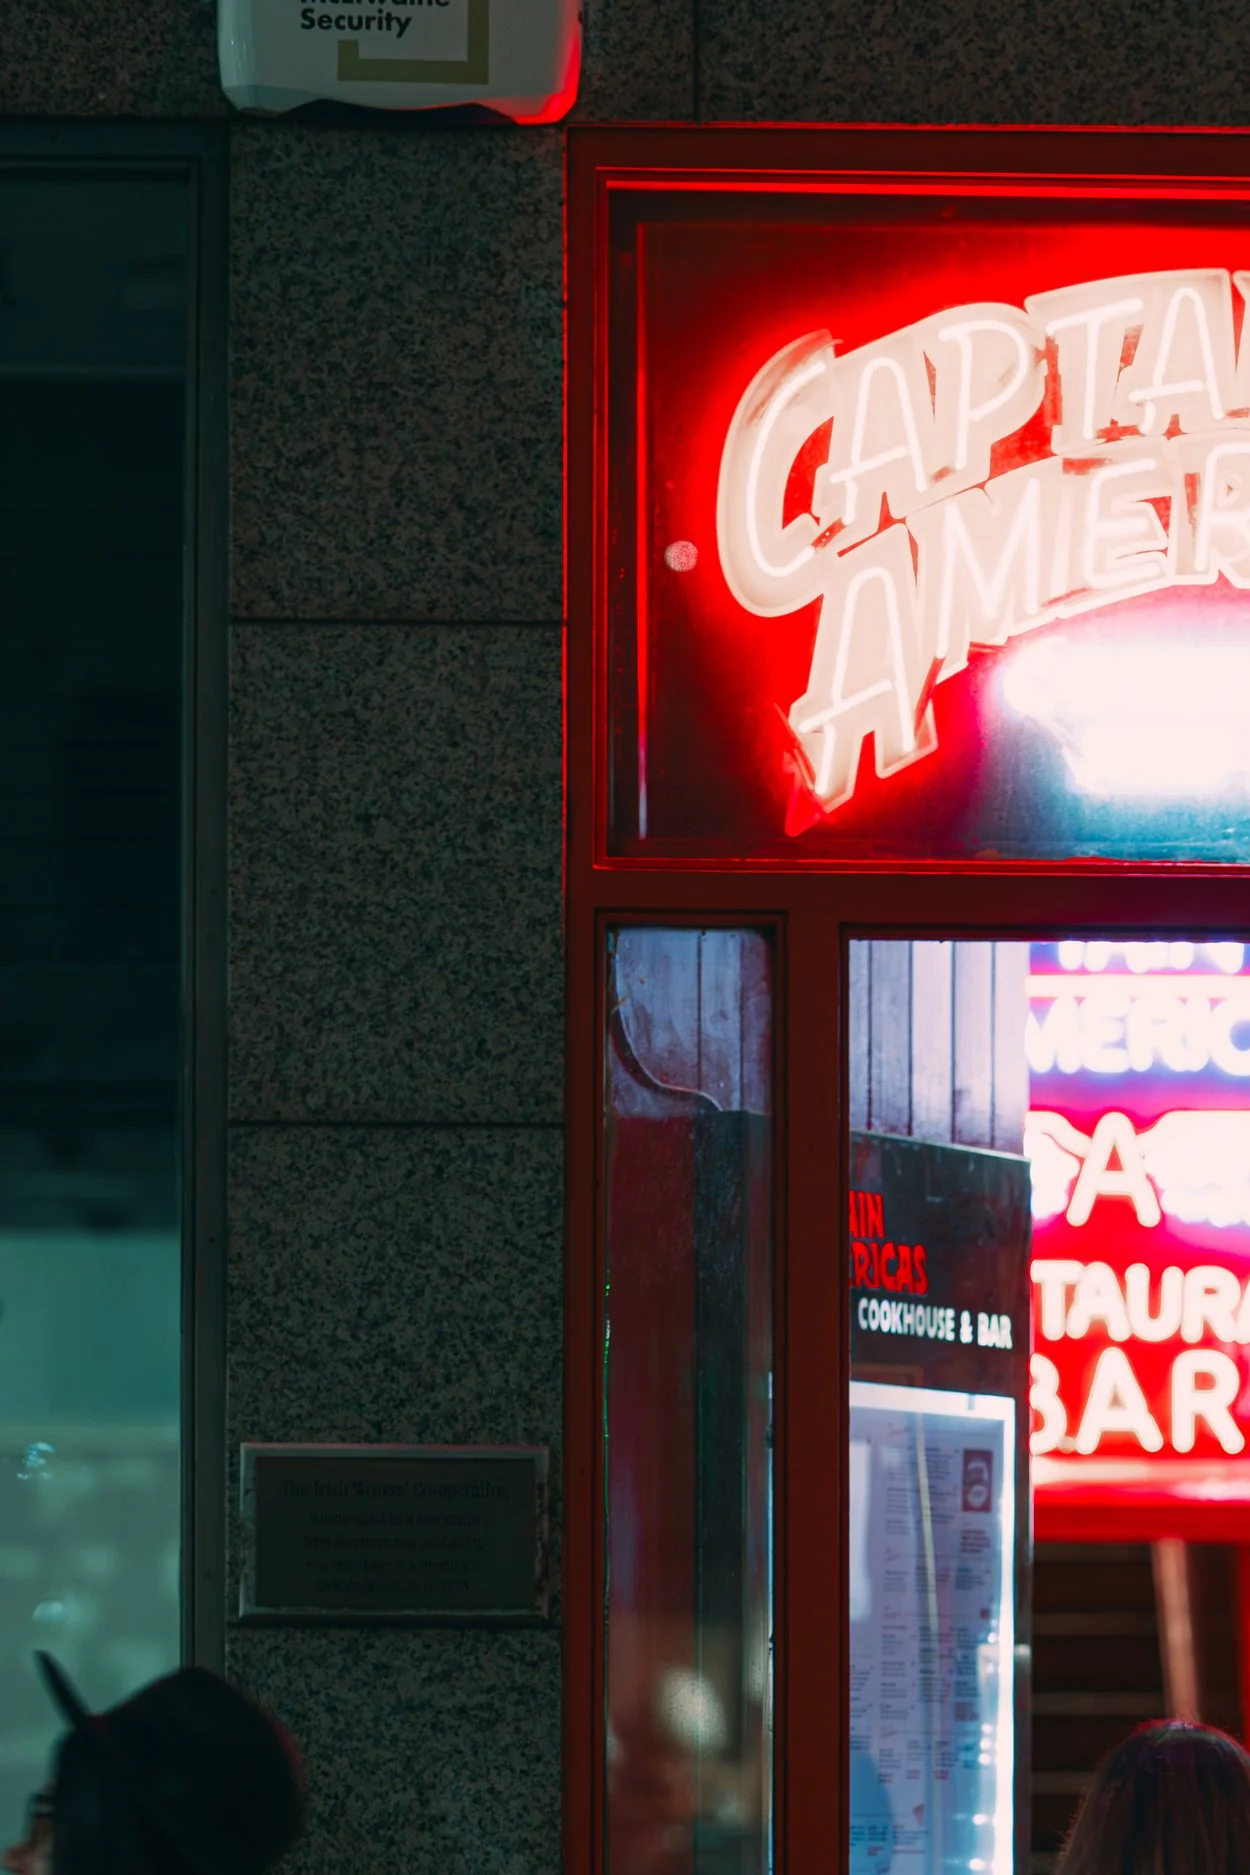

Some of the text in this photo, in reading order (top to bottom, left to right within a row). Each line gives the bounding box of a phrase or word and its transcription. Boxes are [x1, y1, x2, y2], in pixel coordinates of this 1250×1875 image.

[300, 8, 412, 38] Security
[848, 1241, 929, 1296] RICAS
[858, 1297, 1013, 1349] COOKHOUSE & BAR
